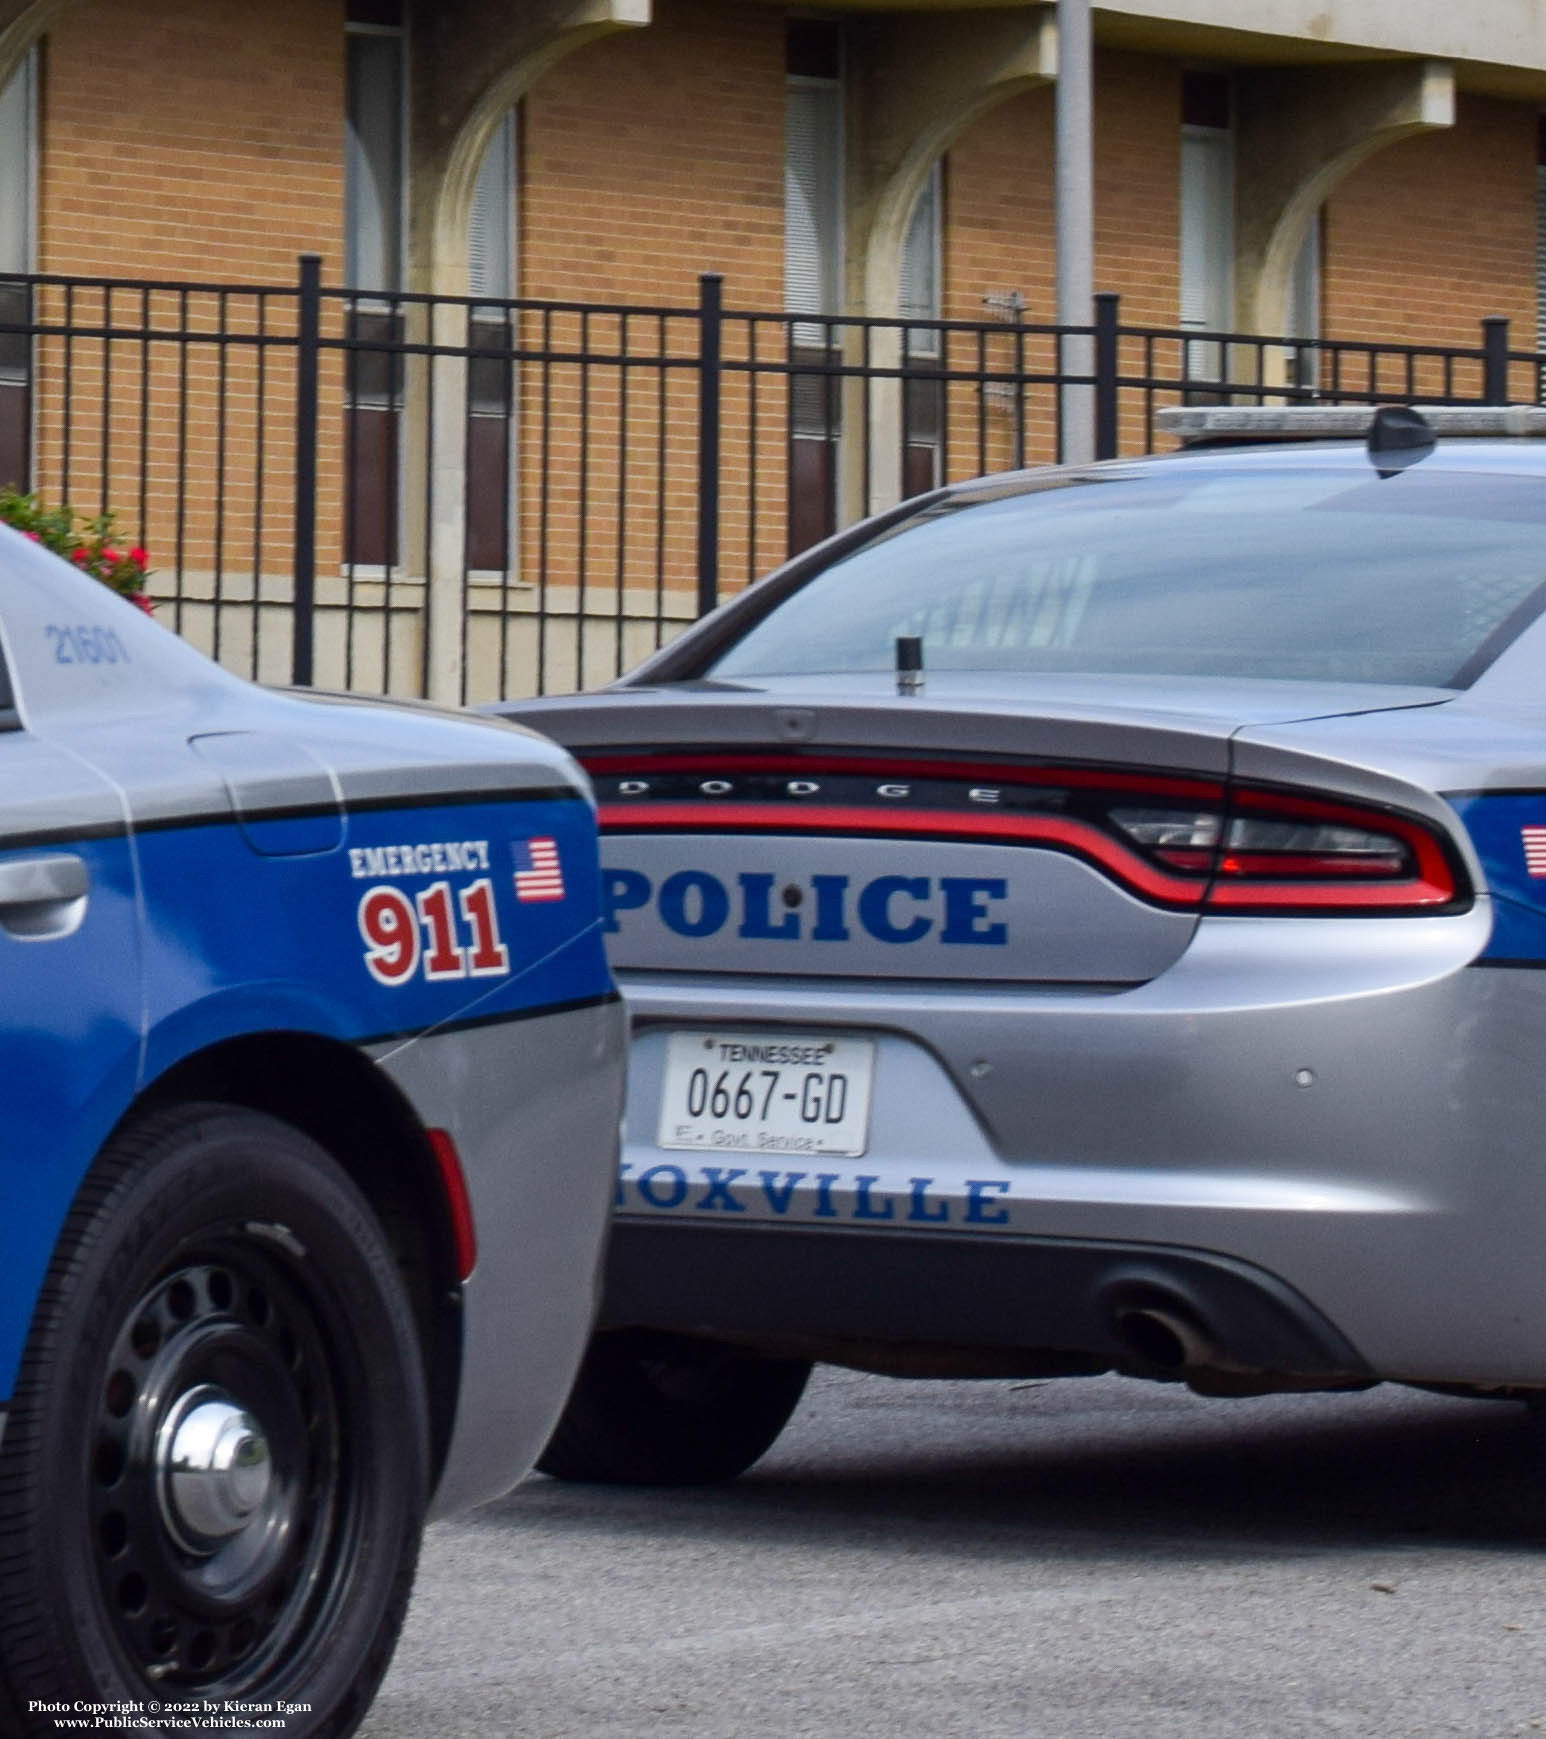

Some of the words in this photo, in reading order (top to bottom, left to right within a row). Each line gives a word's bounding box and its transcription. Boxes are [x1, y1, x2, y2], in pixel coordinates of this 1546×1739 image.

[618, 779, 1001, 803] DODGE
[349, 840, 490, 879] EMERGENCY
[600, 867, 1009, 947] POLICE
[358, 878, 510, 987] 911
[719, 1043, 826, 1066] TENNESSEE
[687, 1067, 848, 1124] 0667-GD
